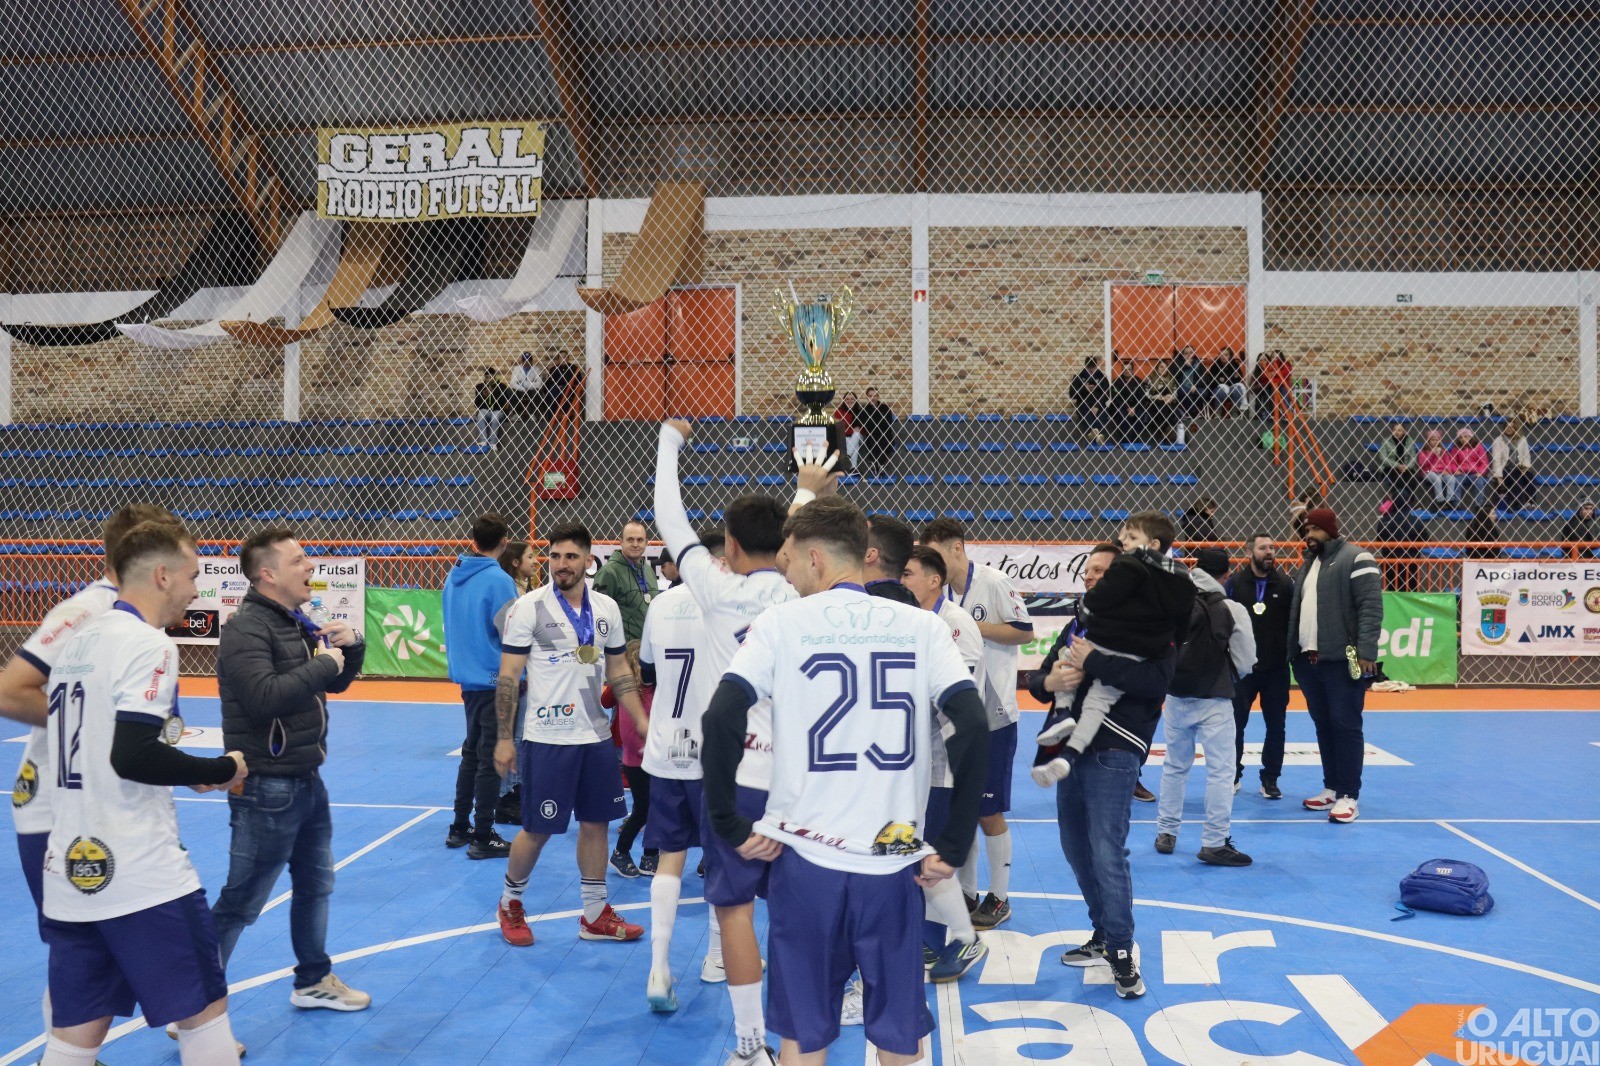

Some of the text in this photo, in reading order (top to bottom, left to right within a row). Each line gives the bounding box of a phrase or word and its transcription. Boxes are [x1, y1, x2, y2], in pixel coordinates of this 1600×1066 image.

[330, 128, 537, 173] GERAL
[327, 174, 537, 218] RODEIO FUTSAL
[204, 563, 243, 575] Escoli
[319, 564, 358, 575] Futsal
[1475, 568, 1578, 583] Apoiadores
[199, 588, 217, 598] edi
[1377, 616, 1435, 658] edi
[1537, 625, 1576, 638] JMX
[800, 633, 917, 648] Plural Odontologia
[664, 648, 695, 719] 7
[800, 651, 916, 772] 25
[48, 681, 83, 790] 12
[72, 863, 102, 877] 1963
